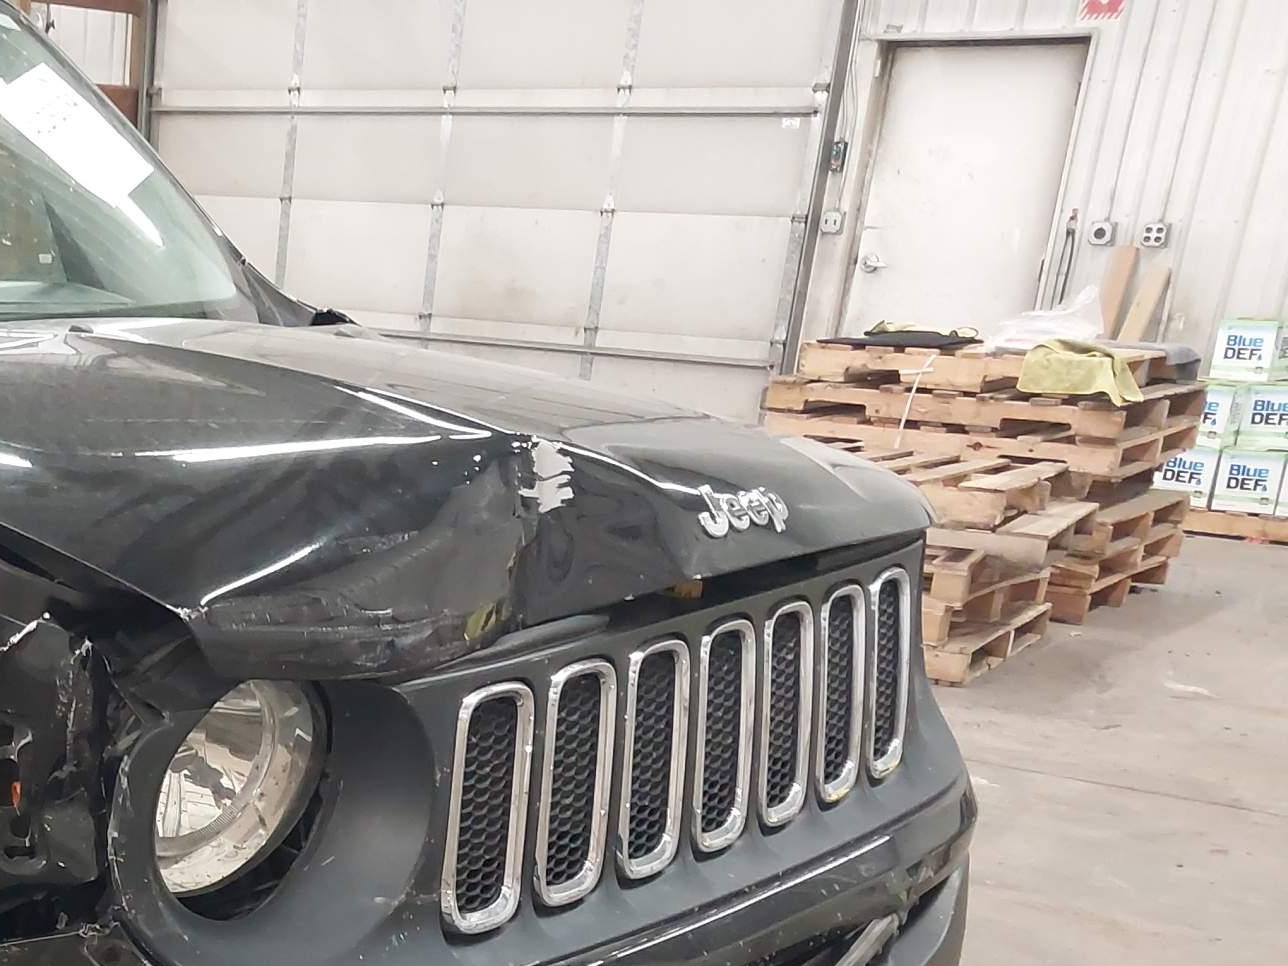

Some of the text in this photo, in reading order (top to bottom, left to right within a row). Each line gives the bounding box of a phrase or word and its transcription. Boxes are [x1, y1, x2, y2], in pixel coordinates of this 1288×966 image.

[1226, 334, 1264, 347] Blue
[1223, 347, 1263, 361] DEF
[1162, 469, 1202, 484] DEF
[1229, 464, 1269, 478] Blue
[1226, 477, 1267, 491] DEF
[697, 484, 788, 537] Jeep
